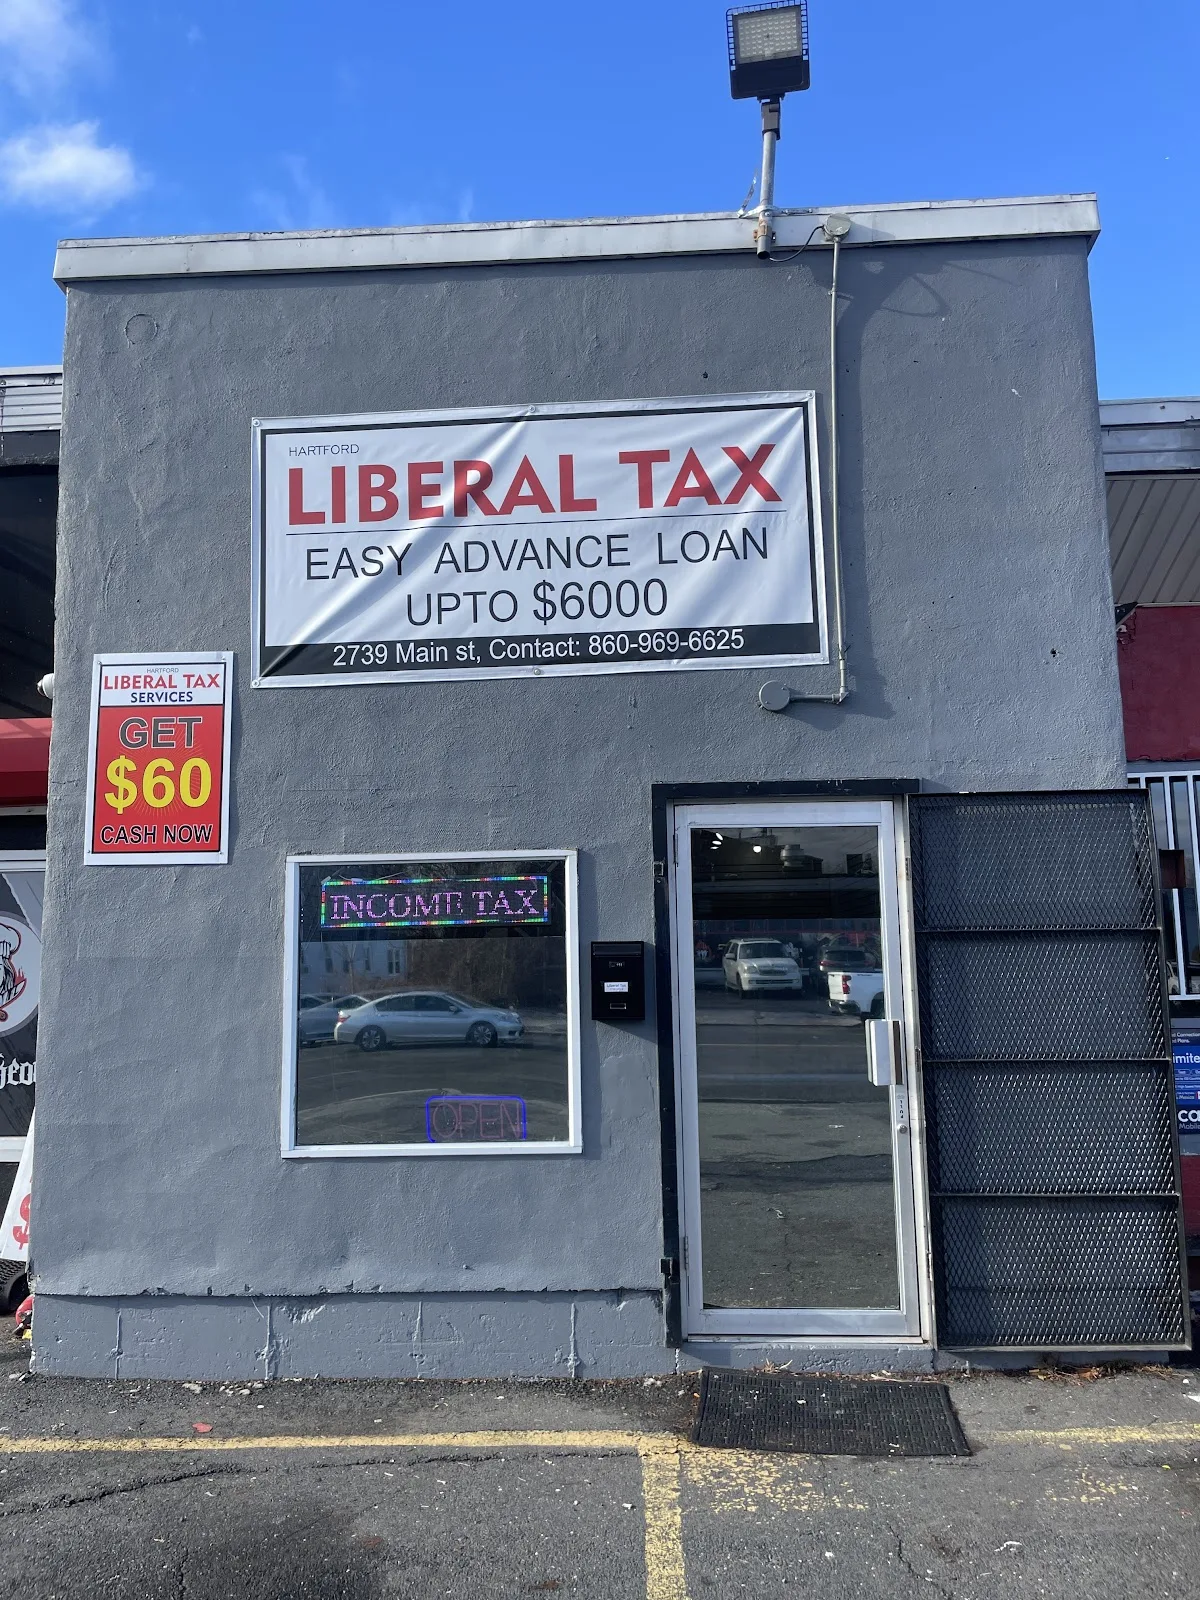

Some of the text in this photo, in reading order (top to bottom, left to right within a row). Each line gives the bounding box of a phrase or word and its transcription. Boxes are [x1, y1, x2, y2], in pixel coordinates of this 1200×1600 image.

[289, 444, 359, 457] HARTFORD
[288, 443, 783, 525] LIBERAL TAX
[306, 527, 768, 580] EASY ADVANCE LOAN
[407, 578, 668, 626] UPTO $6000
[333, 628, 744, 666] 2739 Main st, Contact: 860-969-6625
[104, 673, 220, 690] LIBERAL TAX
[130, 691, 193, 703] SERVICES
[119, 716, 202, 750] GET
[104, 755, 212, 815] $60
[101, 823, 213, 844] CASH NOW
[330, 890, 540, 920] INCOME TAX
[432, 1101, 521, 1139] OPEN
